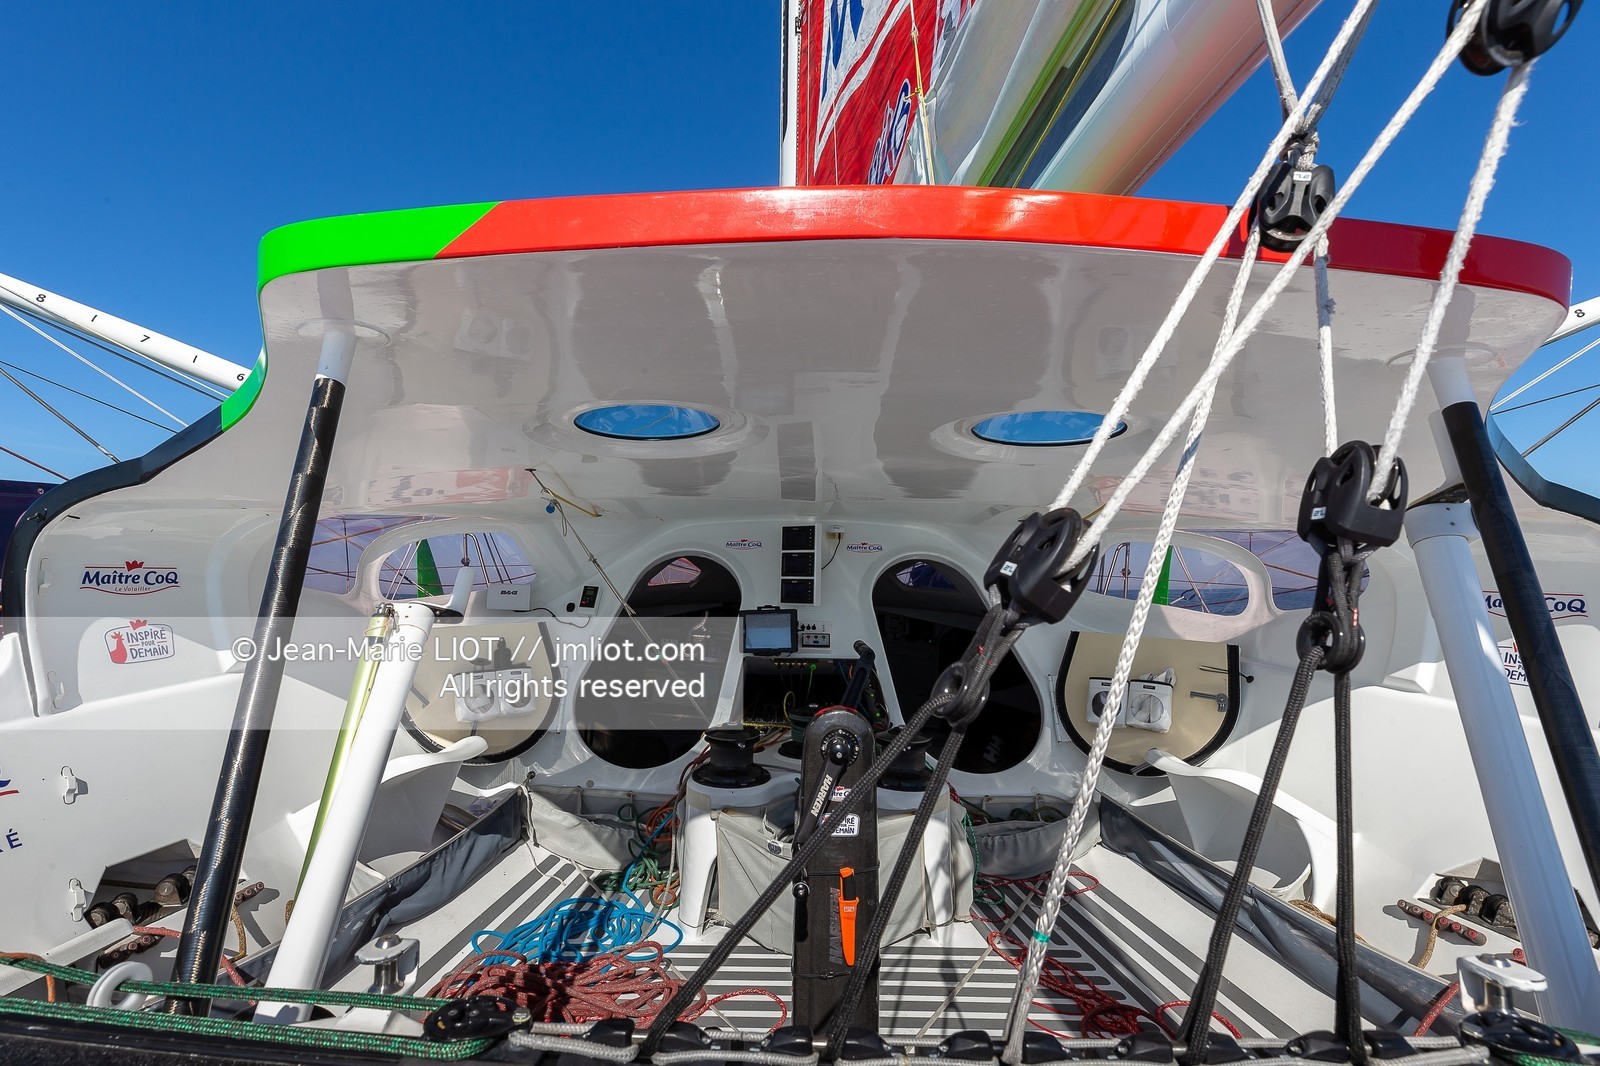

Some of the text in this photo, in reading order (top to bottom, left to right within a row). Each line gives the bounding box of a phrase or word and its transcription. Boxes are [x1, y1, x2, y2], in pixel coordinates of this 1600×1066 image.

[1574, 308, 1586, 318] 8
[35, 293, 47, 303] 8
[140, 334, 151, 343] 7
[236, 372, 245, 382] 6
[81, 570, 180, 587] Maître CoQ
[811, 774, 833, 818] HARKEN
